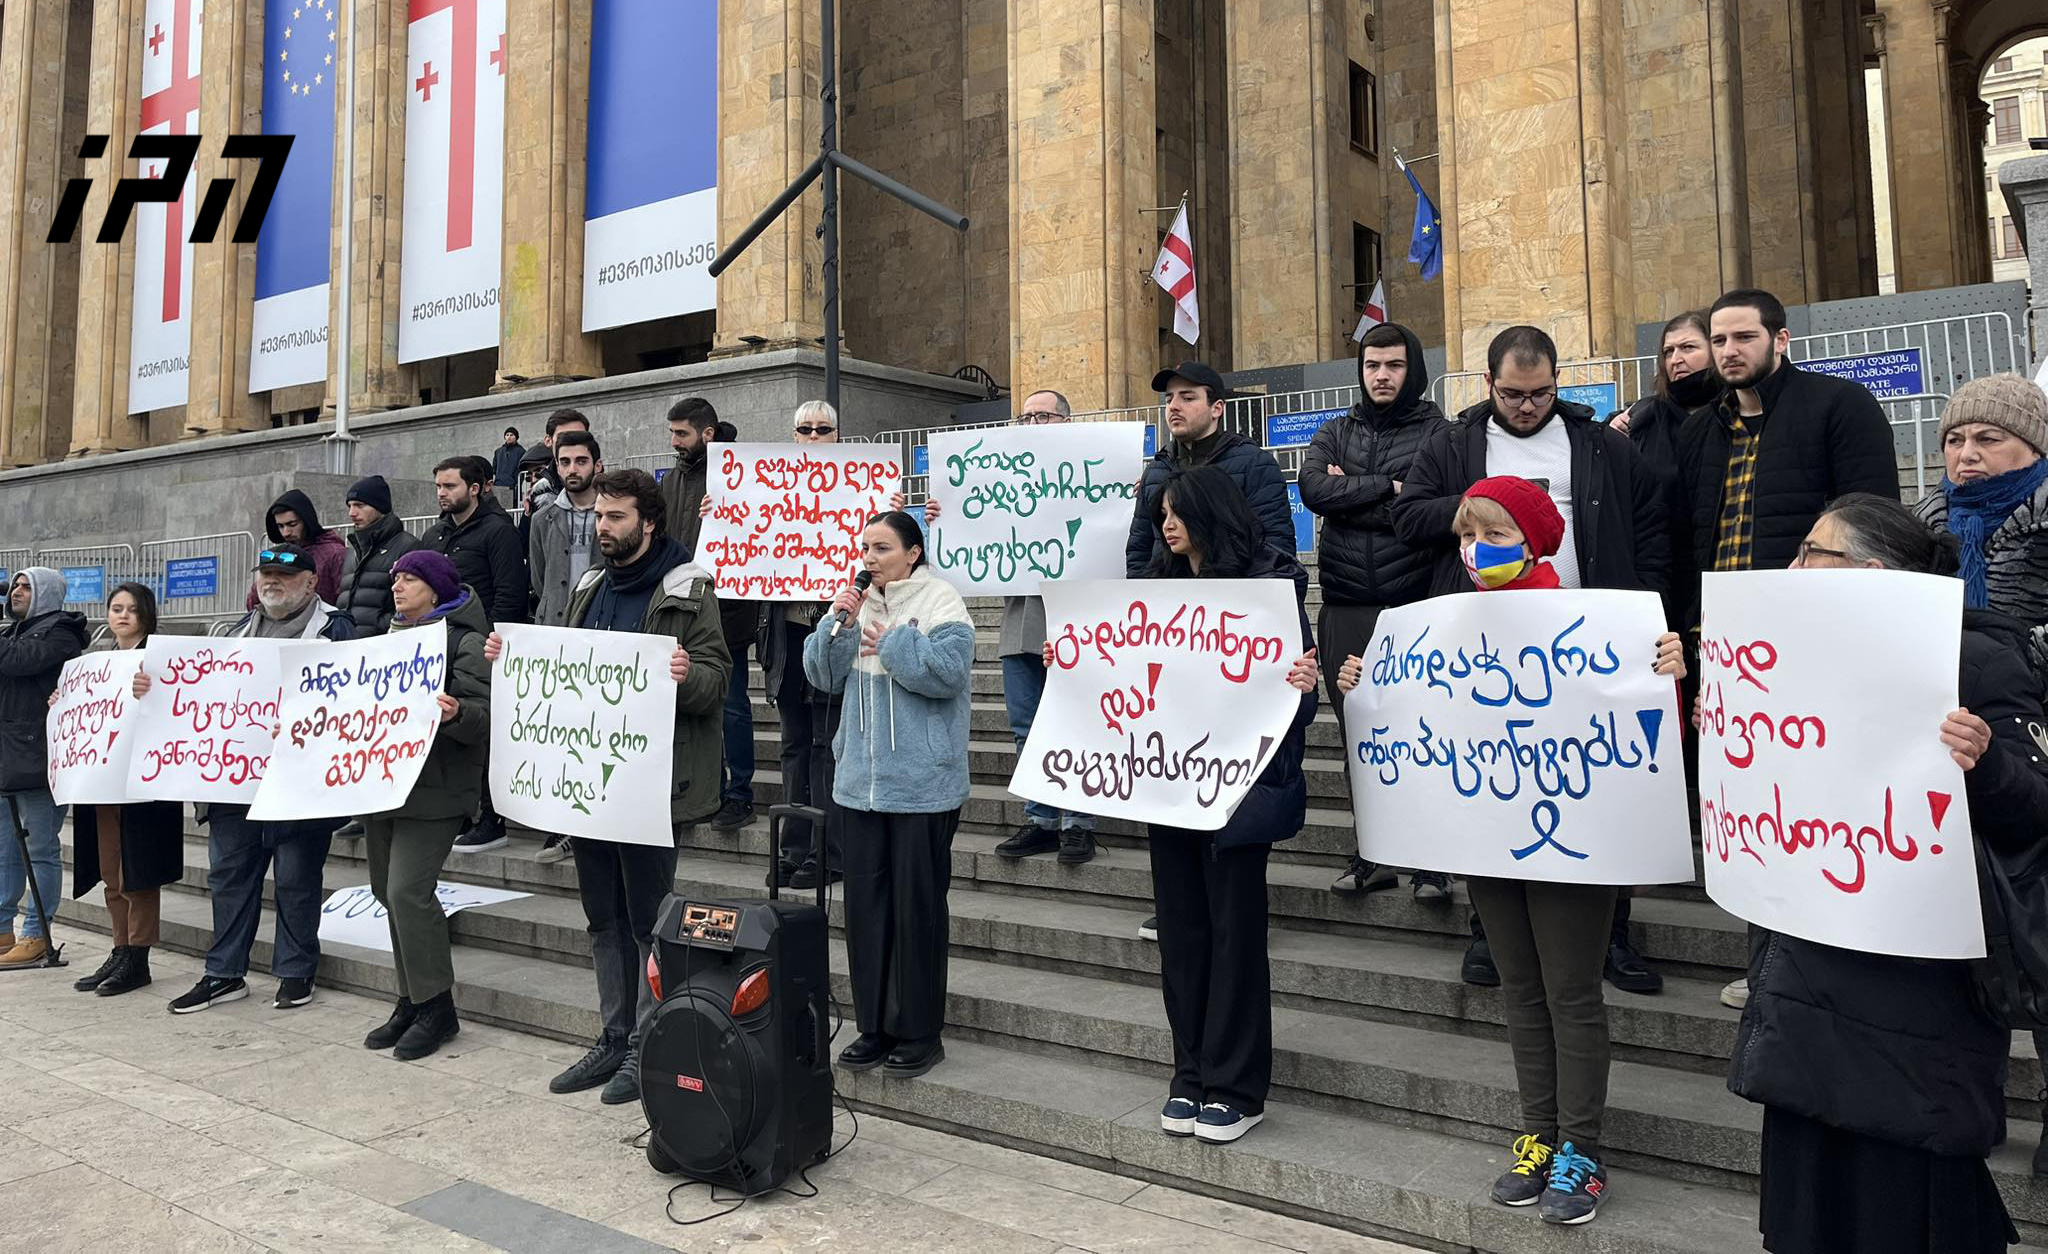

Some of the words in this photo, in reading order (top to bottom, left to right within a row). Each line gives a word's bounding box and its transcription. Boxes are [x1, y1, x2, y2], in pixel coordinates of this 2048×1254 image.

[598, 241, 716, 286] #ევროპისკენ
[1856, 363, 1918, 379] სამსახური
[1862, 379, 1891, 390] TATE
[1867, 353, 1909, 366] დაცვის
[1871, 386, 1910, 398] ERVICE
[722, 449, 744, 490] მე
[755, 452, 838, 493] დავკარგე
[946, 436, 1035, 487] ერთად
[713, 496, 750, 528] ახლა
[705, 534, 768, 567] თქვენი
[936, 517, 1083, 583] სიცოცხლე!
[159, 648, 254, 685] კავშირი
[1054, 600, 1284, 683] გადამირჩინეთ
[1372, 615, 1621, 708] მხარდაჭერა
[1701, 634, 1778, 694] თად
[300, 661, 351, 702] მინდა
[357, 642, 444, 701] სიცოცხლე
[503, 640, 648, 706] სიცოცხლისთვის
[1100, 662, 1163, 735] და!
[291, 703, 409, 749] დამიდექით
[510, 700, 601, 764] ბრძოლის
[608, 714, 648, 763] დრო
[1042, 730, 1275, 809] დაგვეხმარეთ!
[1357, 709, 1664, 801] ონკოპაციენტებს!
[509, 760, 543, 800] არის
[551, 762, 616, 815] ახლა!
